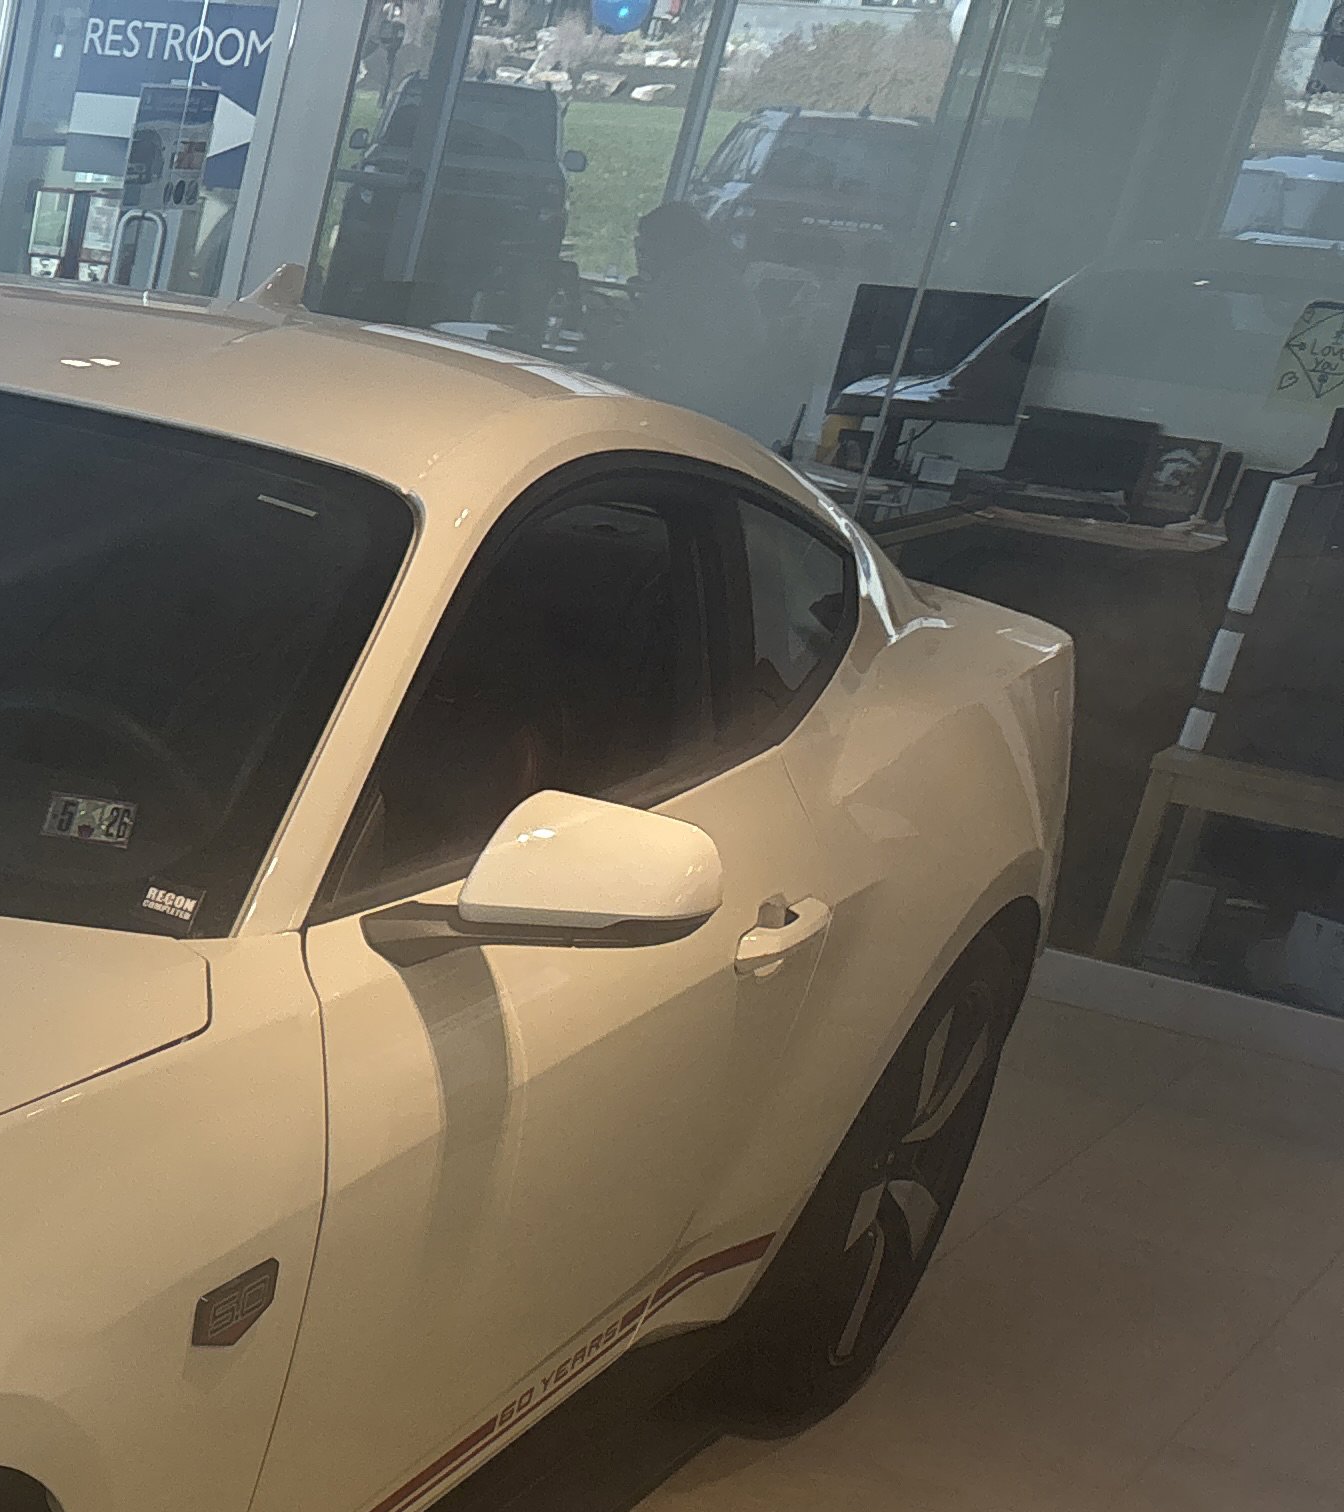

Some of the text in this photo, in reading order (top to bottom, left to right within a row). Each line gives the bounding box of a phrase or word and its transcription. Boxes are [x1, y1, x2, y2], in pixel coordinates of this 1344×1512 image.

[57, 801, 131, 838] 5 26
[146, 886, 198, 912] RECON
[208, 1275, 270, 1339] 5.0
[498, 1324, 620, 1427] 60 YEARS
